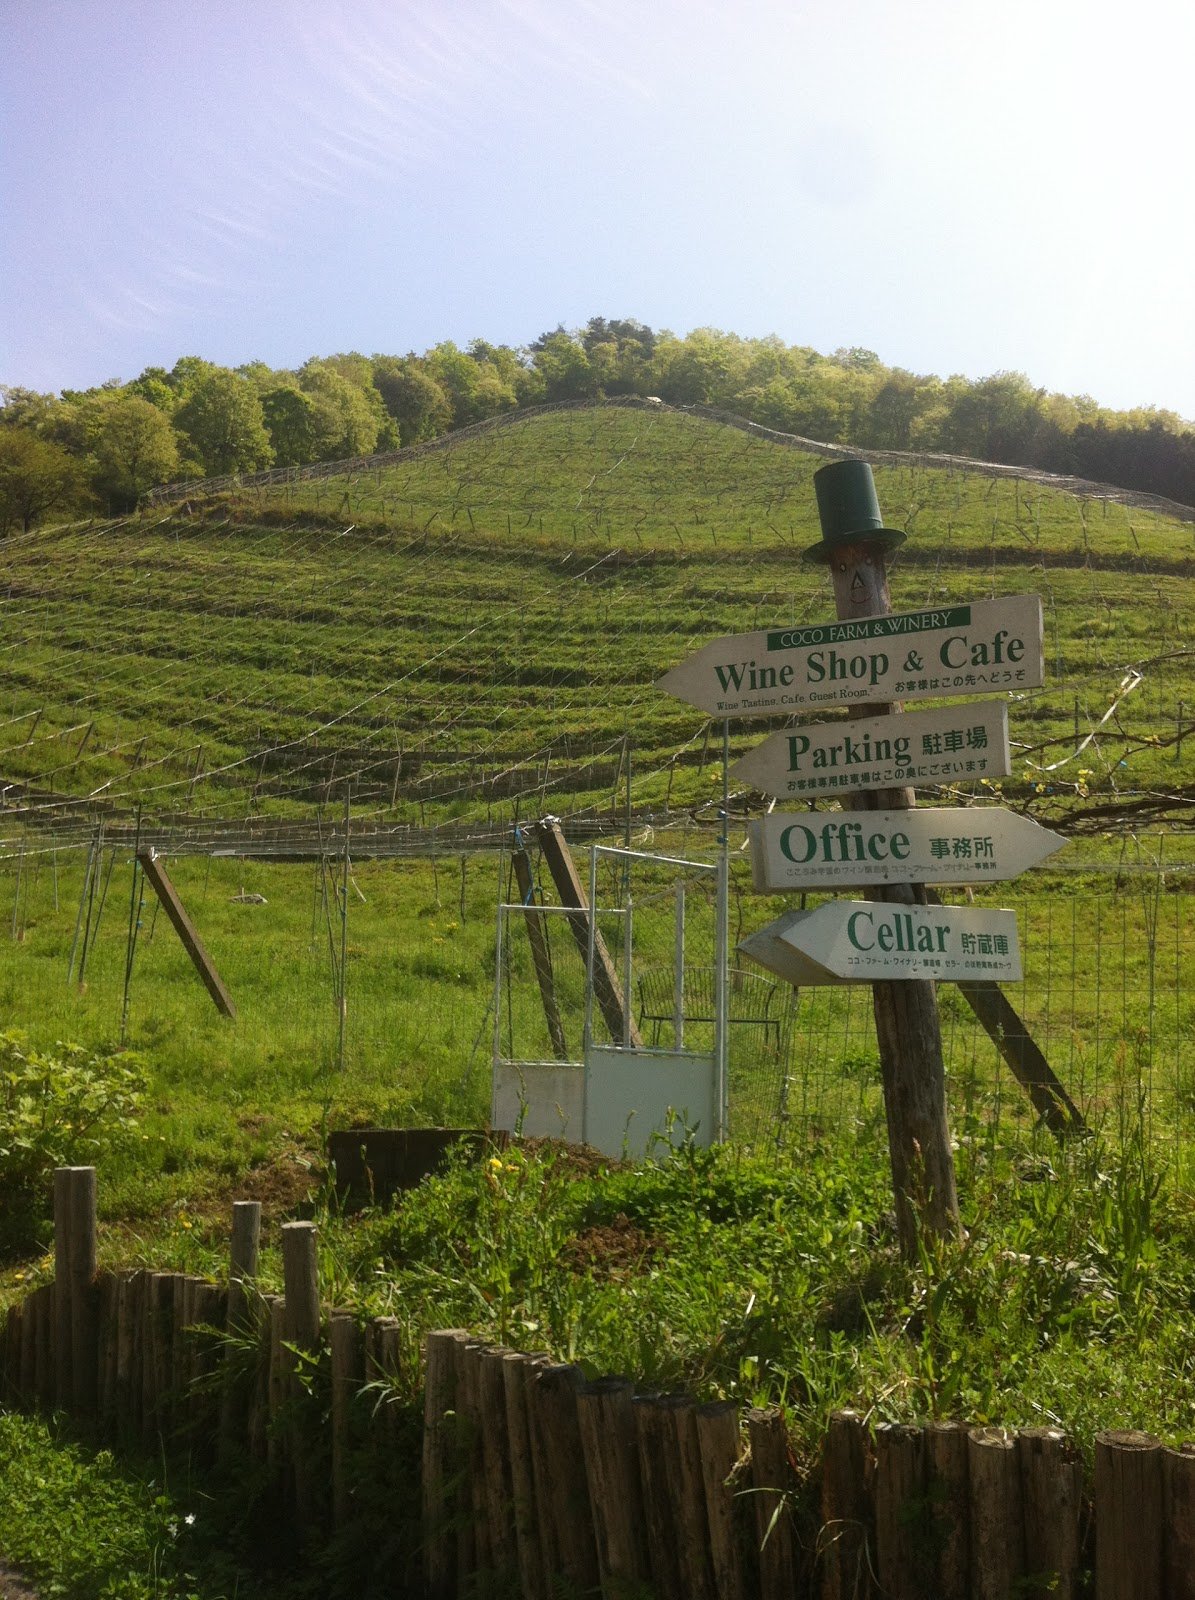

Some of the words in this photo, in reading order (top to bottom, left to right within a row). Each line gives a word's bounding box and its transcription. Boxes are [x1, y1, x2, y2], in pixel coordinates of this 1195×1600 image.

[781, 630, 823, 648] COCO
[829, 622, 869, 642] FARM
[873, 620, 884, 635] &
[886, 611, 952, 633] WINERY
[713, 660, 794, 693] Wine
[806, 645, 889, 685] Shop
[902, 650, 925, 673] &
[939, 630, 1025, 669] Cafe
[894, 669, 1026, 693] お客様はこの先へどうぞ
[716, 701, 739, 711] Wine
[809, 691, 838, 702] Guest
[785, 733, 911, 773] Parking
[922, 726, 988, 756] 駐車場
[786, 758, 989, 791] お客様専用駐車場はこの奥にございます
[779, 823, 911, 864] Office
[928, 836, 995, 860] 事務所
[846, 910, 951, 954] Cellar
[960, 933, 1010, 957] 貯蔵庫
